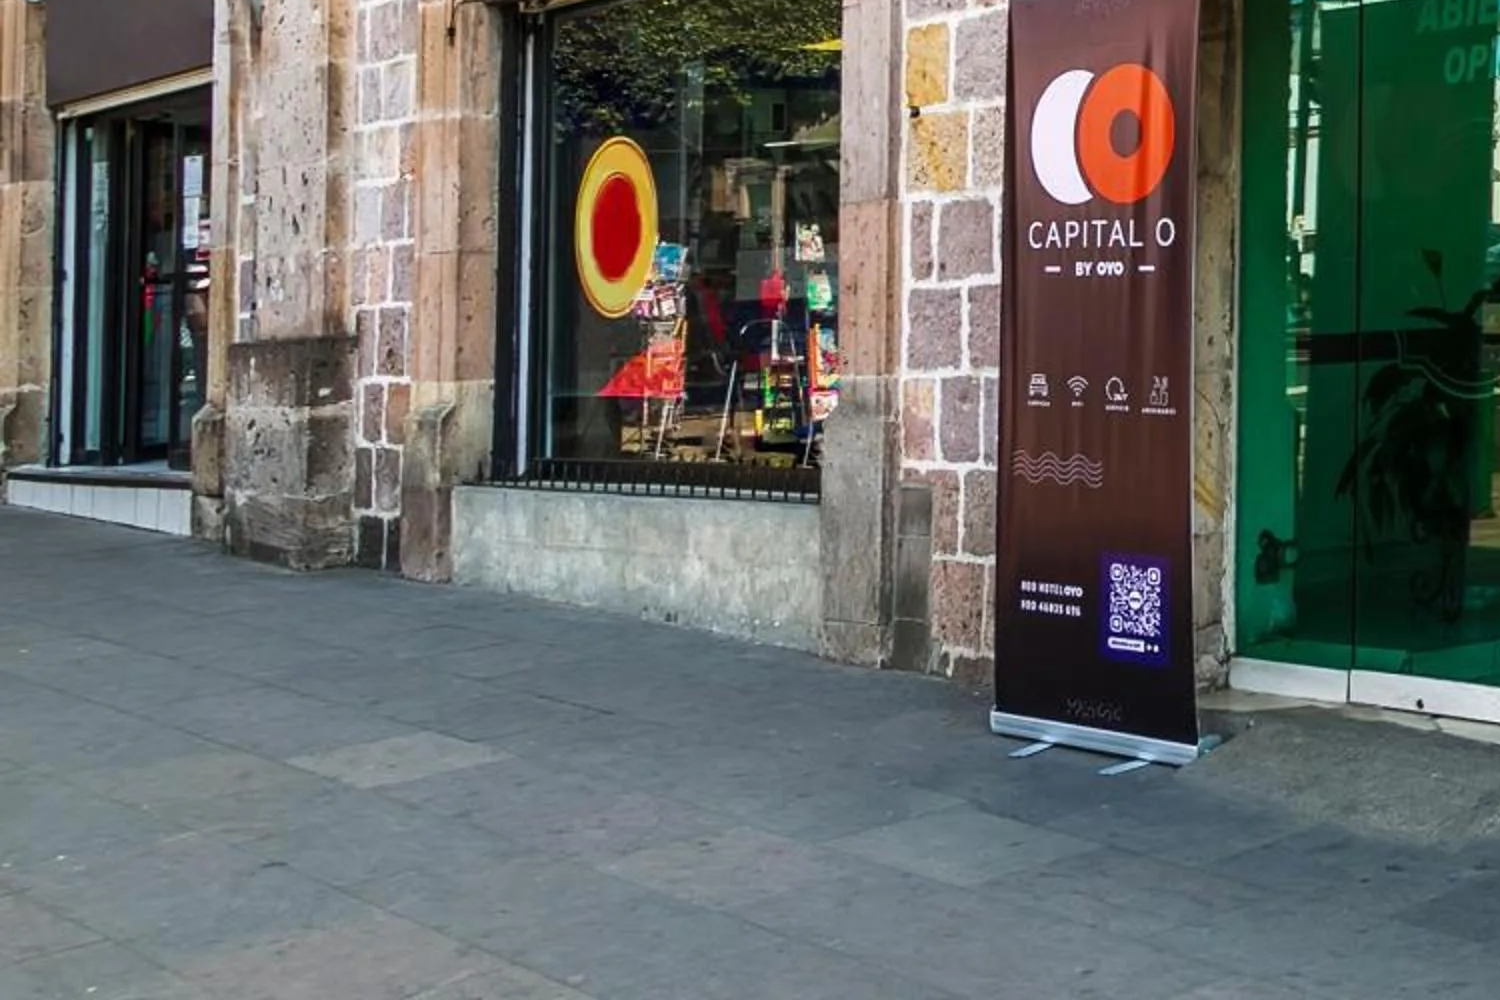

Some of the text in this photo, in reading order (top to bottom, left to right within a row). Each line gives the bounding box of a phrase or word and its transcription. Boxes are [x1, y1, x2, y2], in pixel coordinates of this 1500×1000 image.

[1027, 217, 1176, 250] CAPITAL O
[1074, 260, 1125, 277] BY OYO
